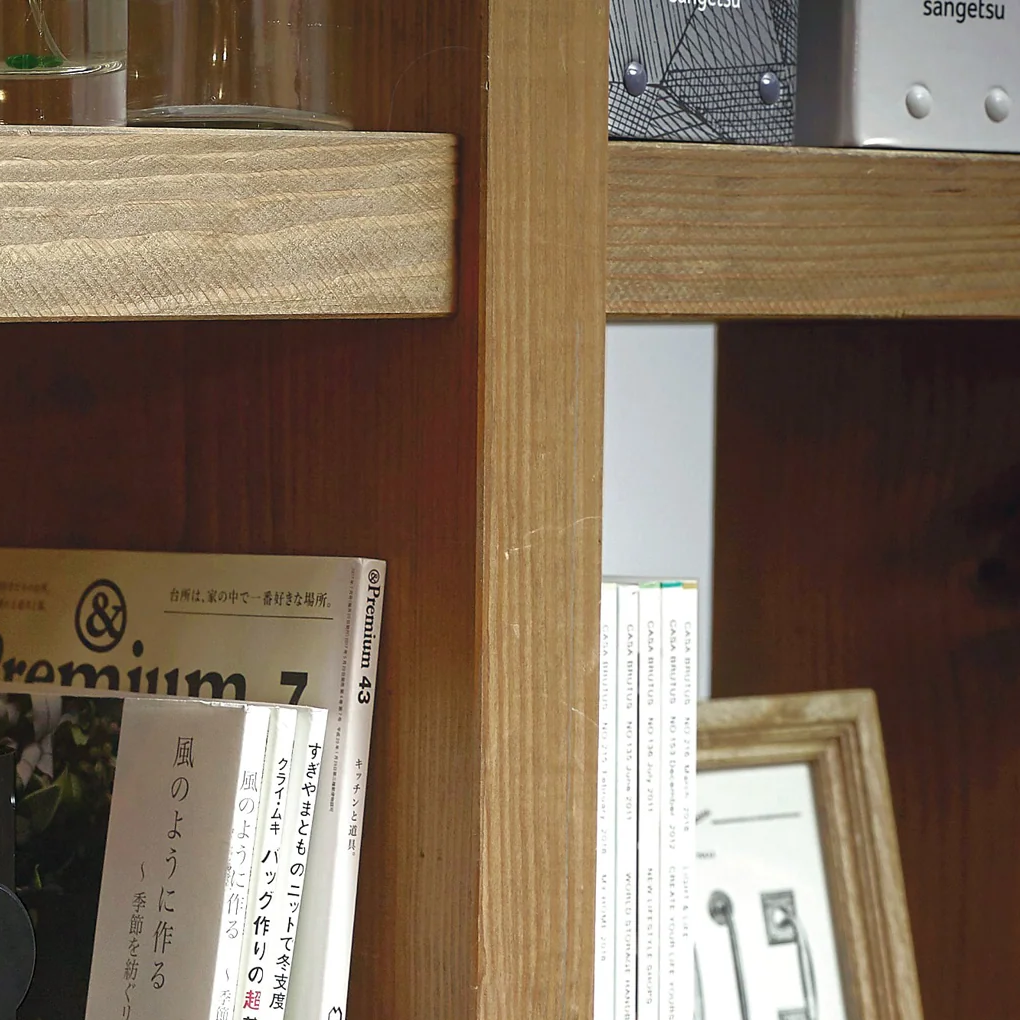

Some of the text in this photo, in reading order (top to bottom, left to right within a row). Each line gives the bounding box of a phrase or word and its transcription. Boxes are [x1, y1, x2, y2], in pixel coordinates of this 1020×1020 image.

[923, 0, 1005, 24] sangetsu
[280, 671, 308, 705] 7
[357, 675, 372, 705] 43
[269, 757, 288, 836] クライ・ムキ
[150, 736, 194, 989] 風のように作る
[225, 770, 258, 939] 風のように作る
